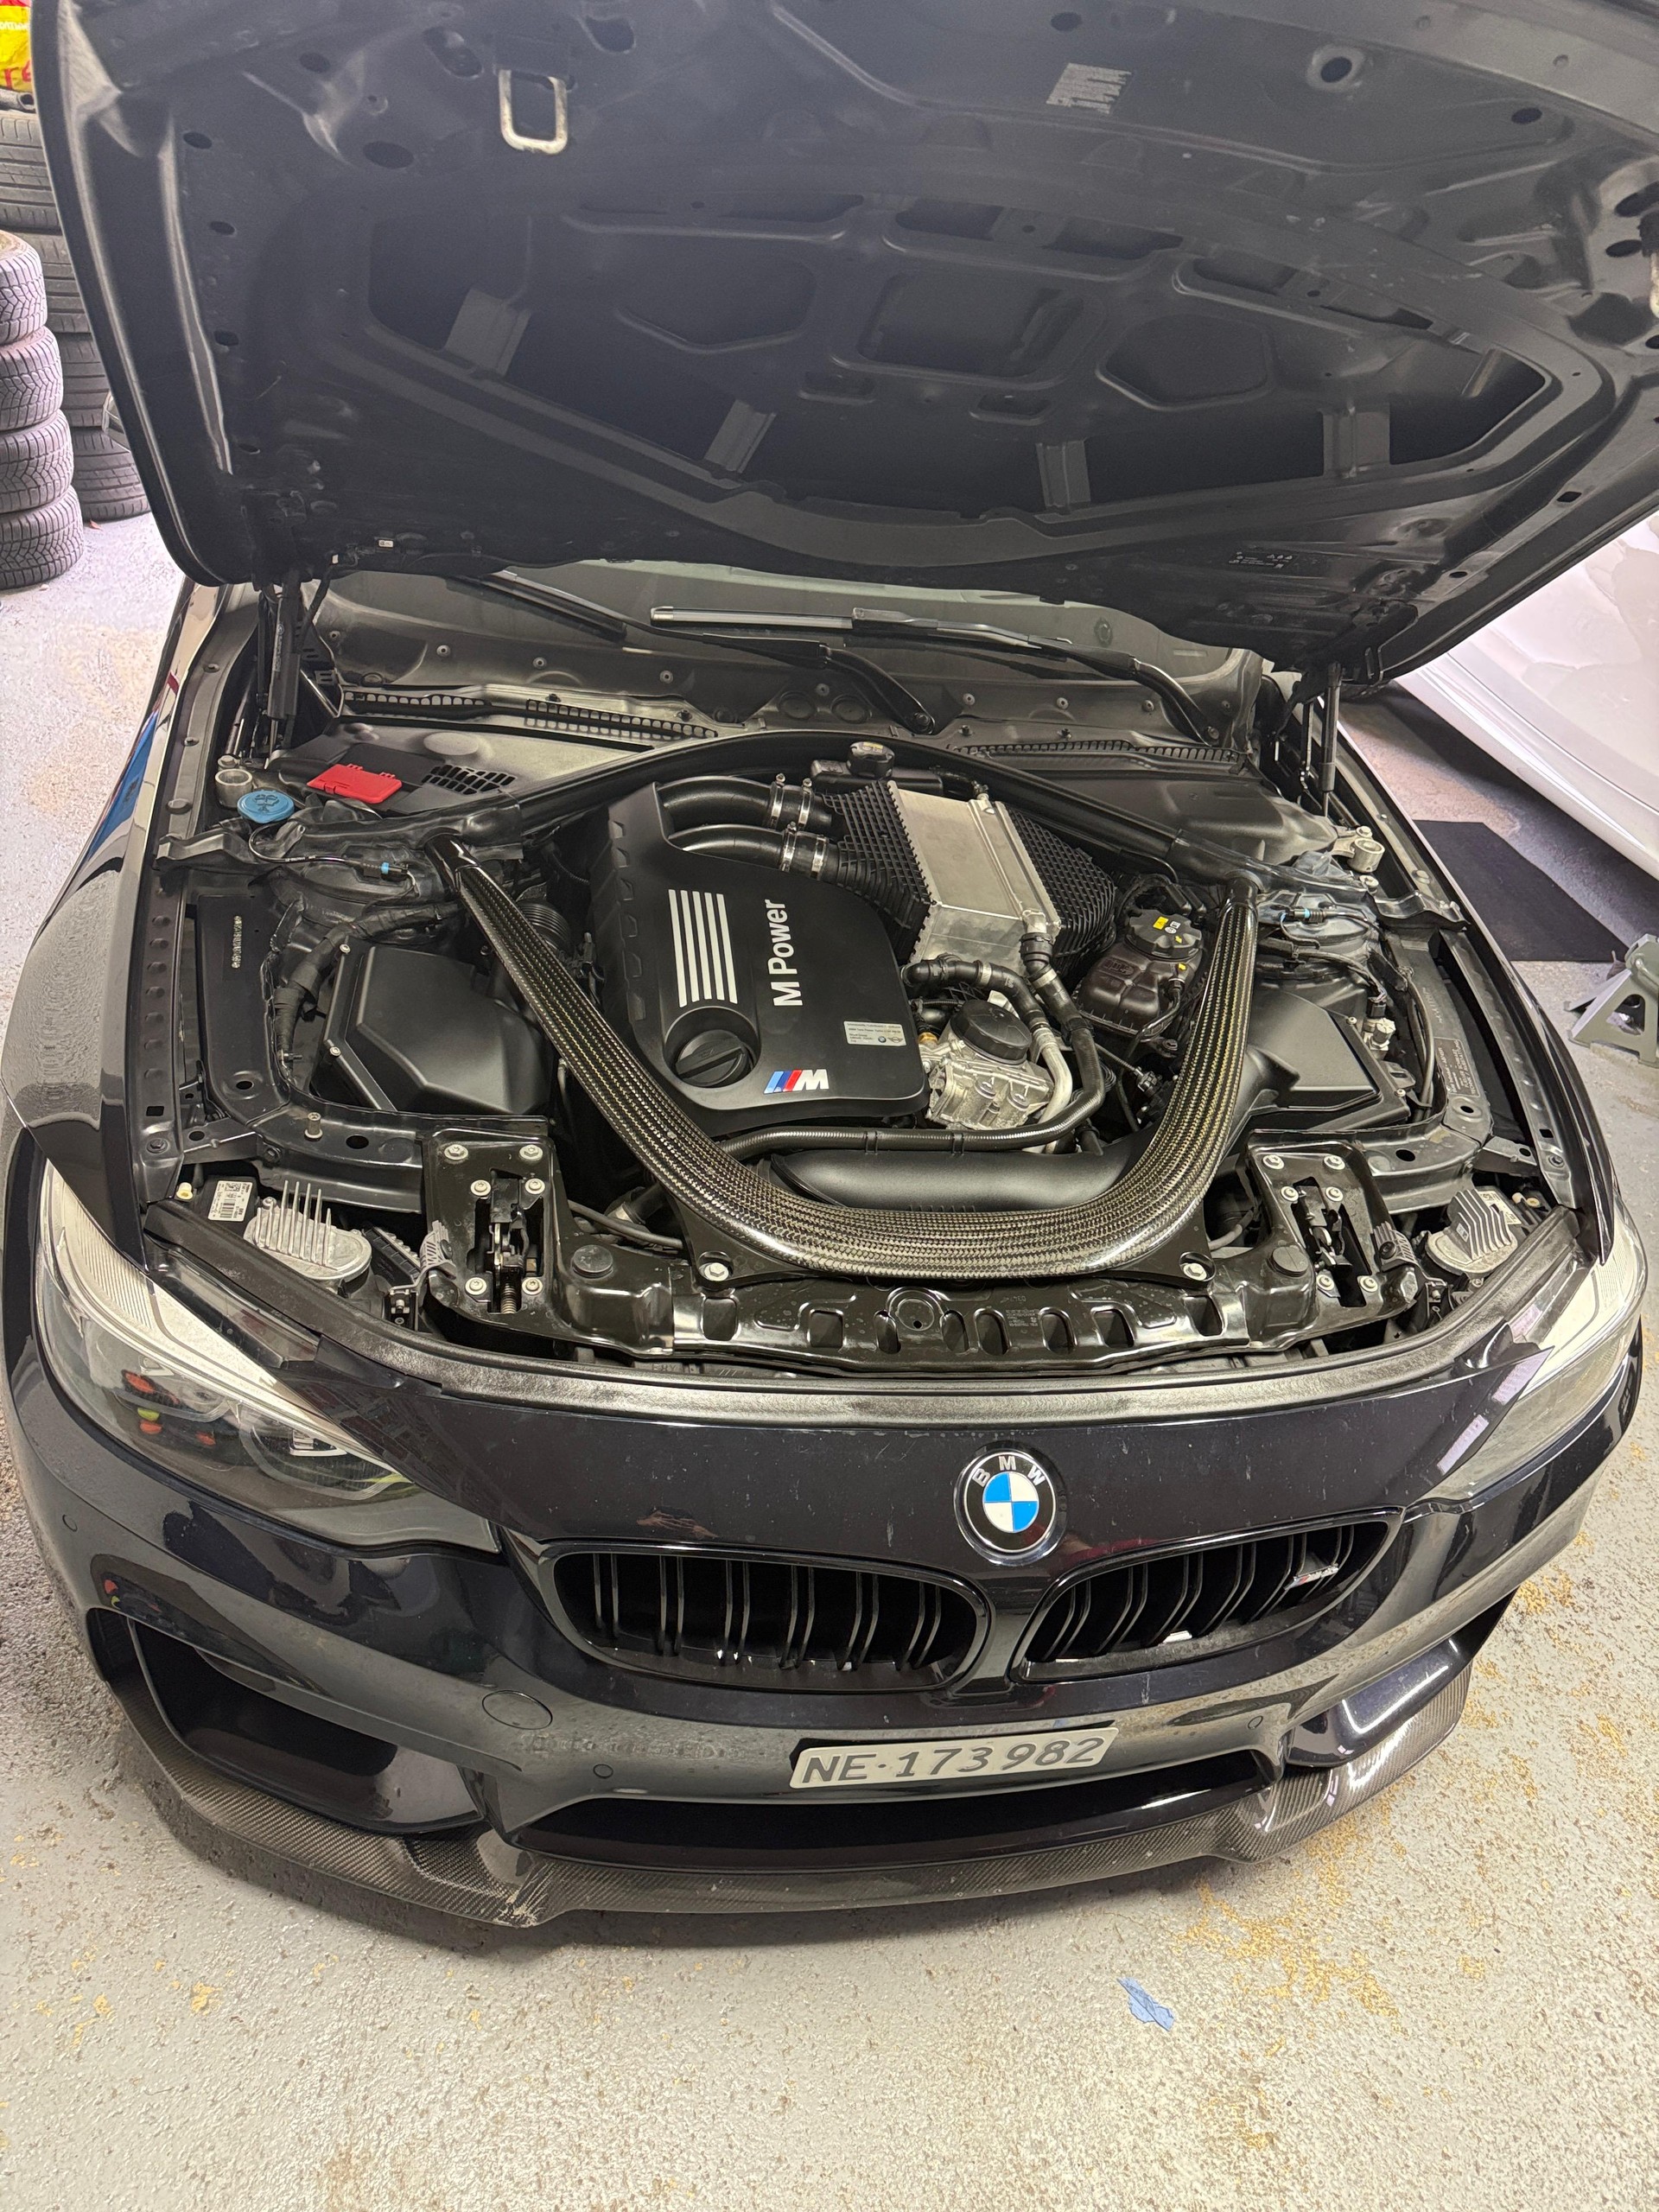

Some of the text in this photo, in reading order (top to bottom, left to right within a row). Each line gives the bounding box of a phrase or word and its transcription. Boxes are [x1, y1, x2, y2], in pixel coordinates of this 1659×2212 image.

[765, 899, 803, 1006] M Power
[972, 1455, 1046, 1488] BMW
[1000, 1737, 1105, 1771] 982
